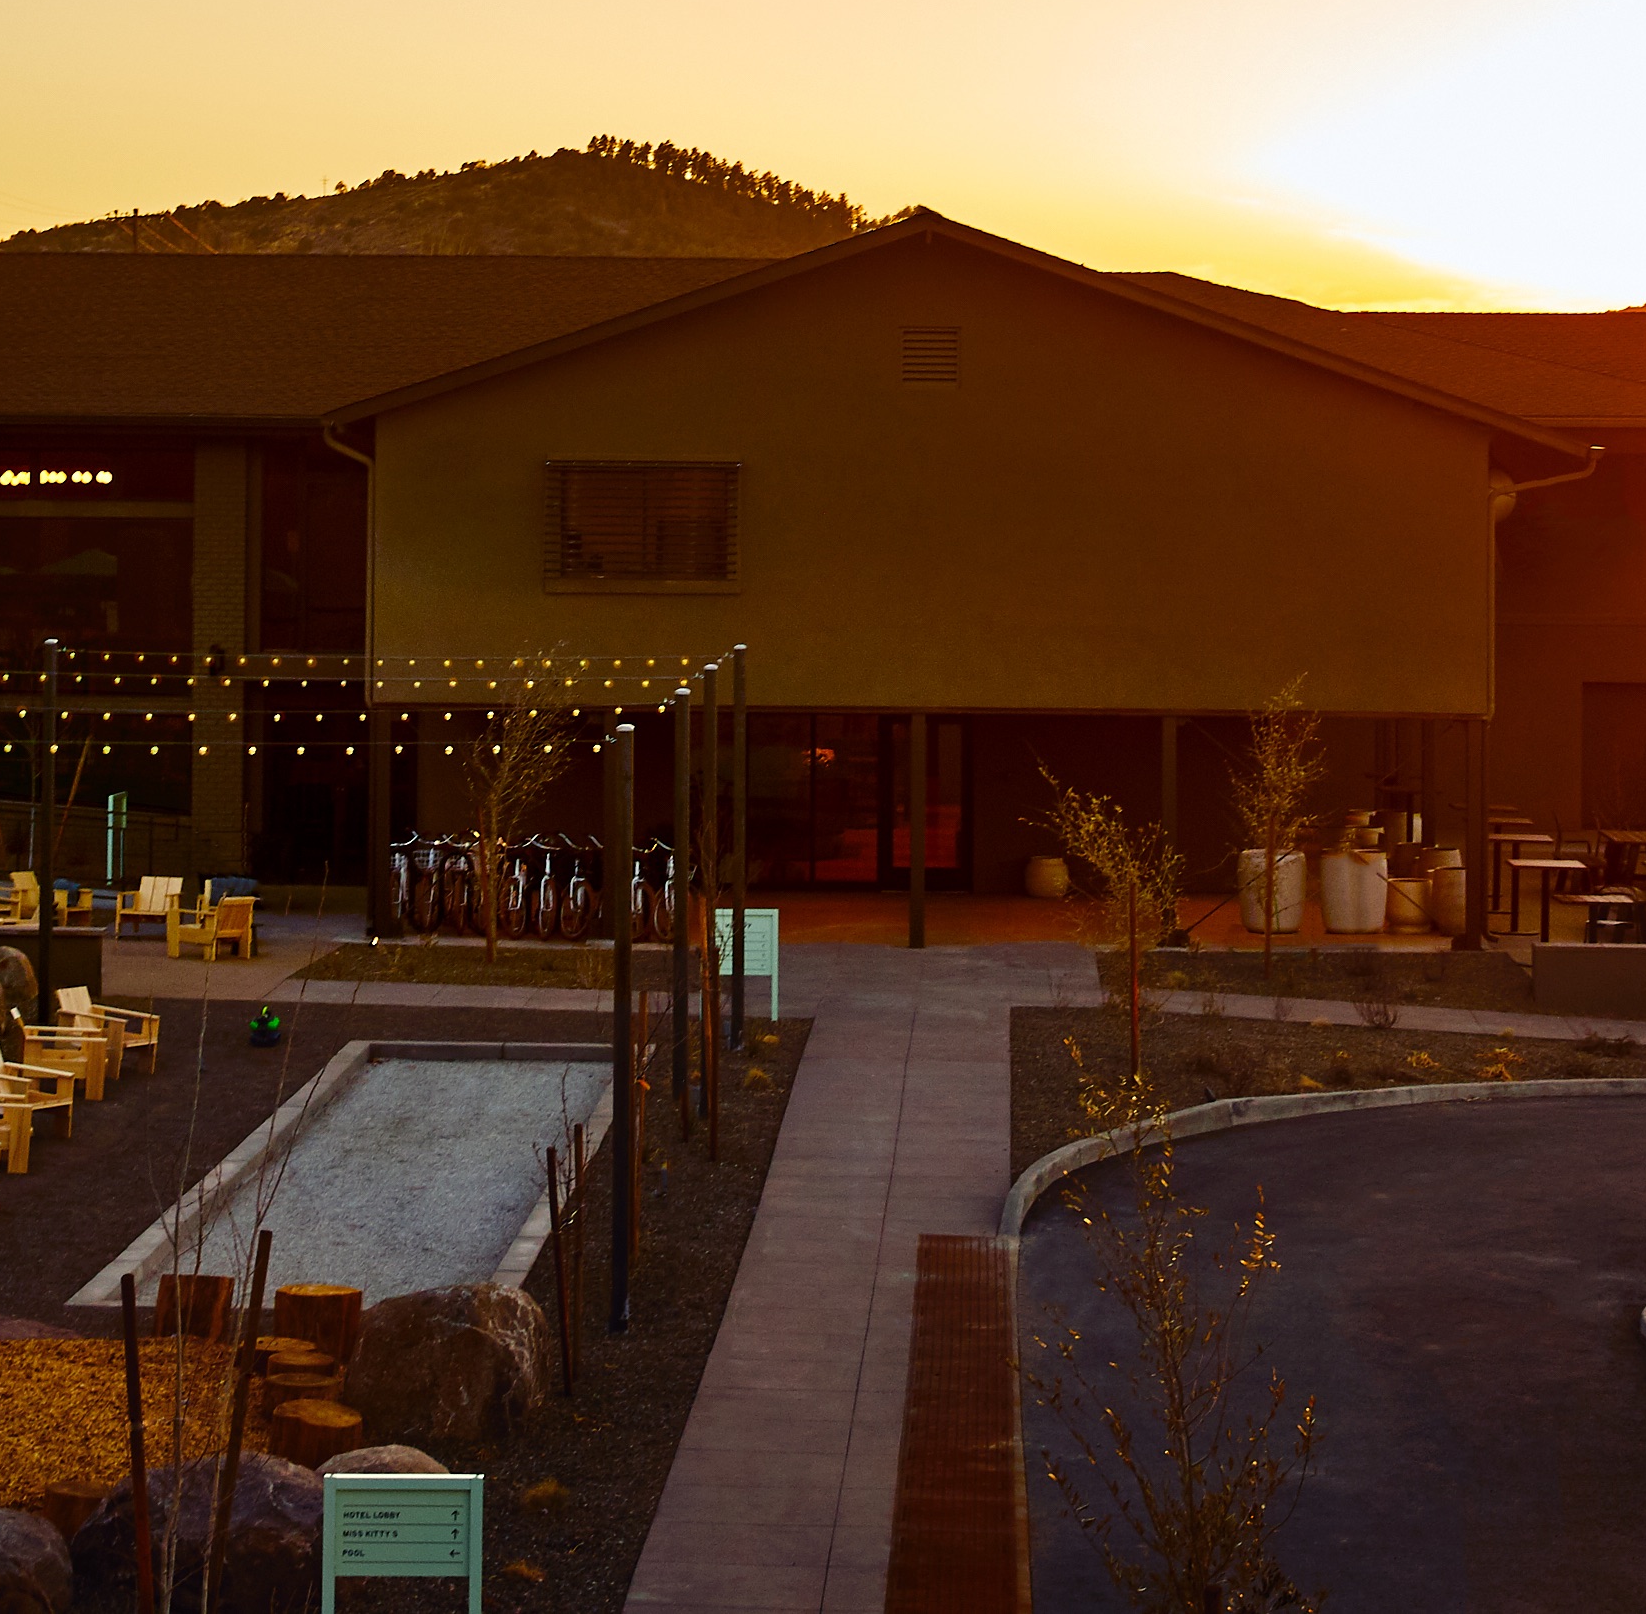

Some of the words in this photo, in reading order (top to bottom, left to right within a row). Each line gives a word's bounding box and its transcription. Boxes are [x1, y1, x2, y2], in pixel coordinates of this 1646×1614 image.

[343, 1511, 371, 1519] HOTEL
[373, 1511, 401, 1519] LOBBY
[342, 1529, 364, 1538] MISS
[365, 1529, 399, 1538] KITTYS
[342, 1549, 365, 1557] POOL
